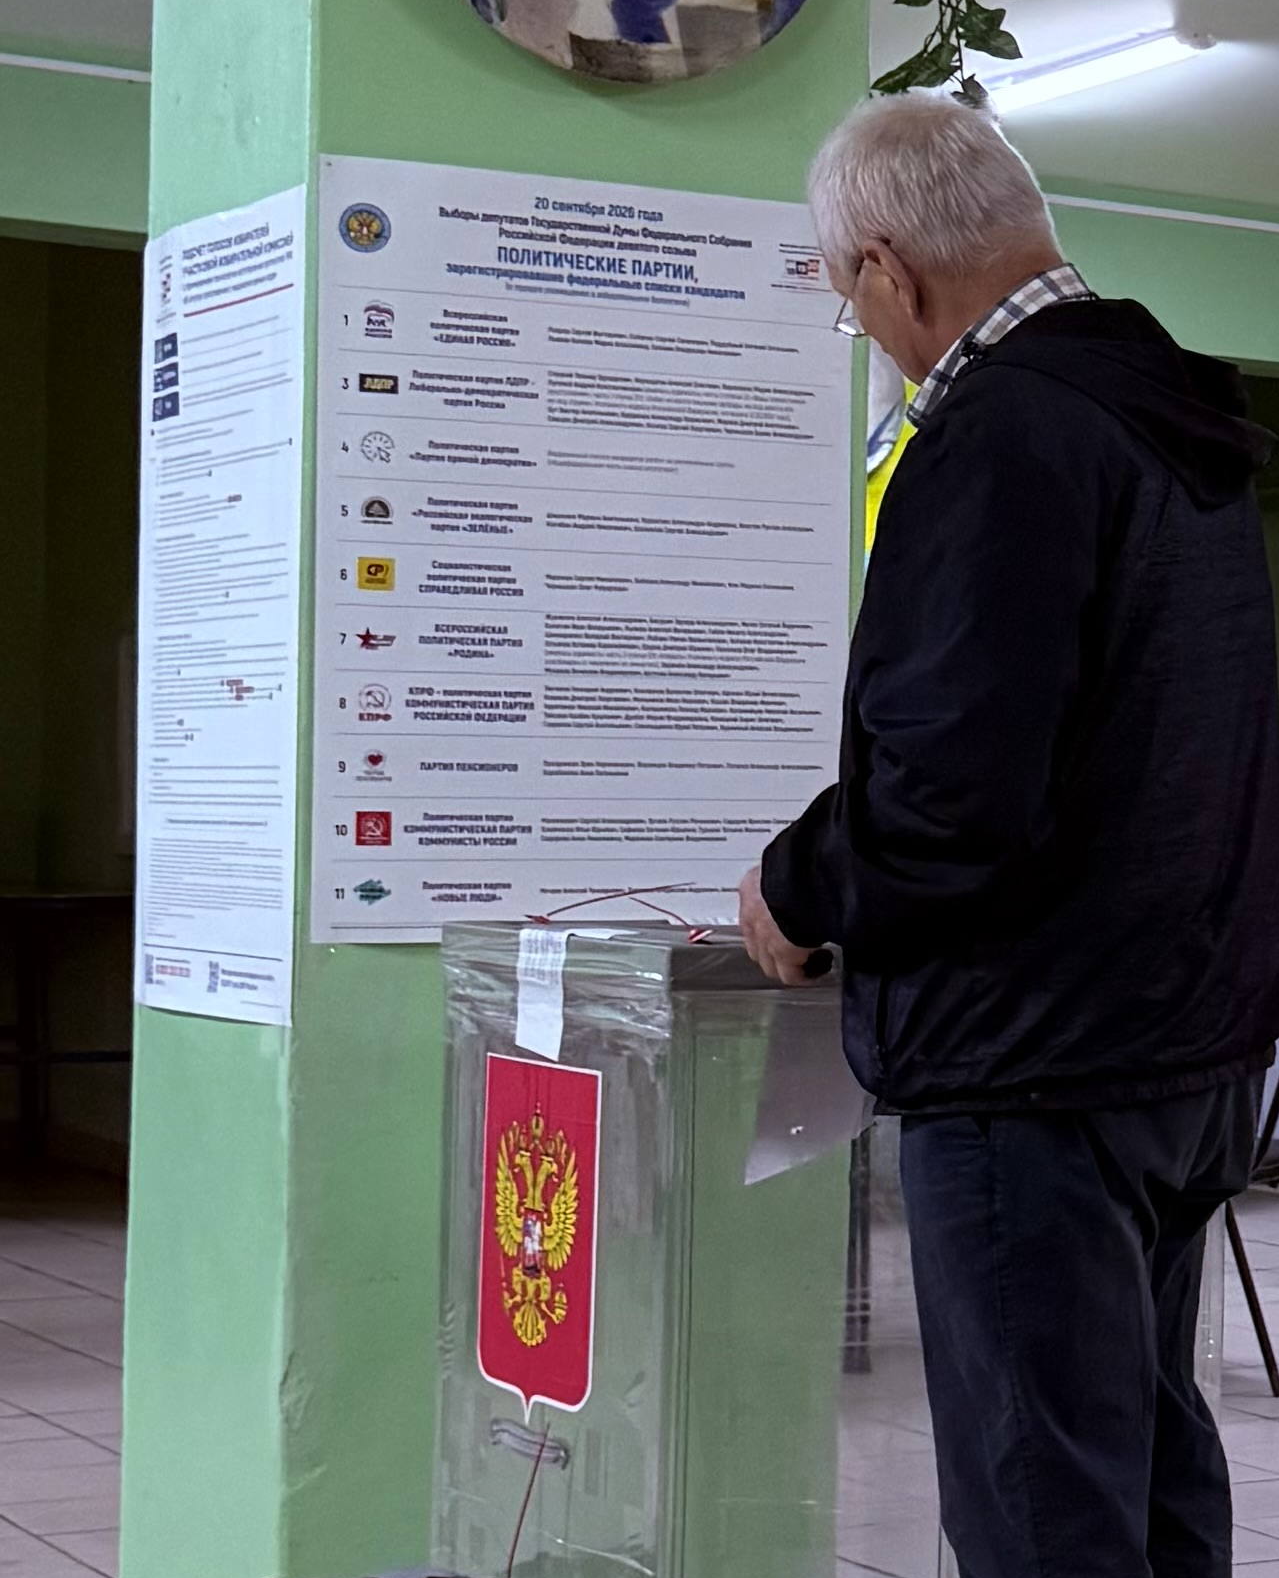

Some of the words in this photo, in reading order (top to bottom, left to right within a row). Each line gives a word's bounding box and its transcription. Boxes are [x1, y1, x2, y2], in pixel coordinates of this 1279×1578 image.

[534, 197, 549, 210] 20
[552, 200, 605, 217] сентября
[638, 209, 663, 222] года
[497, 245, 627, 275] ПОЛИТИЧЕСКИЕ
[632, 258, 699, 283] ПАРТИИ,
[342, 377, 350, 390] 3
[341, 441, 349, 453] 4
[341, 504, 349, 517] 5
[340, 568, 348, 581] 6
[340, 632, 347, 645] 7
[339, 697, 347, 710] 8
[338, 760, 346, 773] 9
[335, 824, 348, 837] 10
[335, 887, 345, 900] 11
